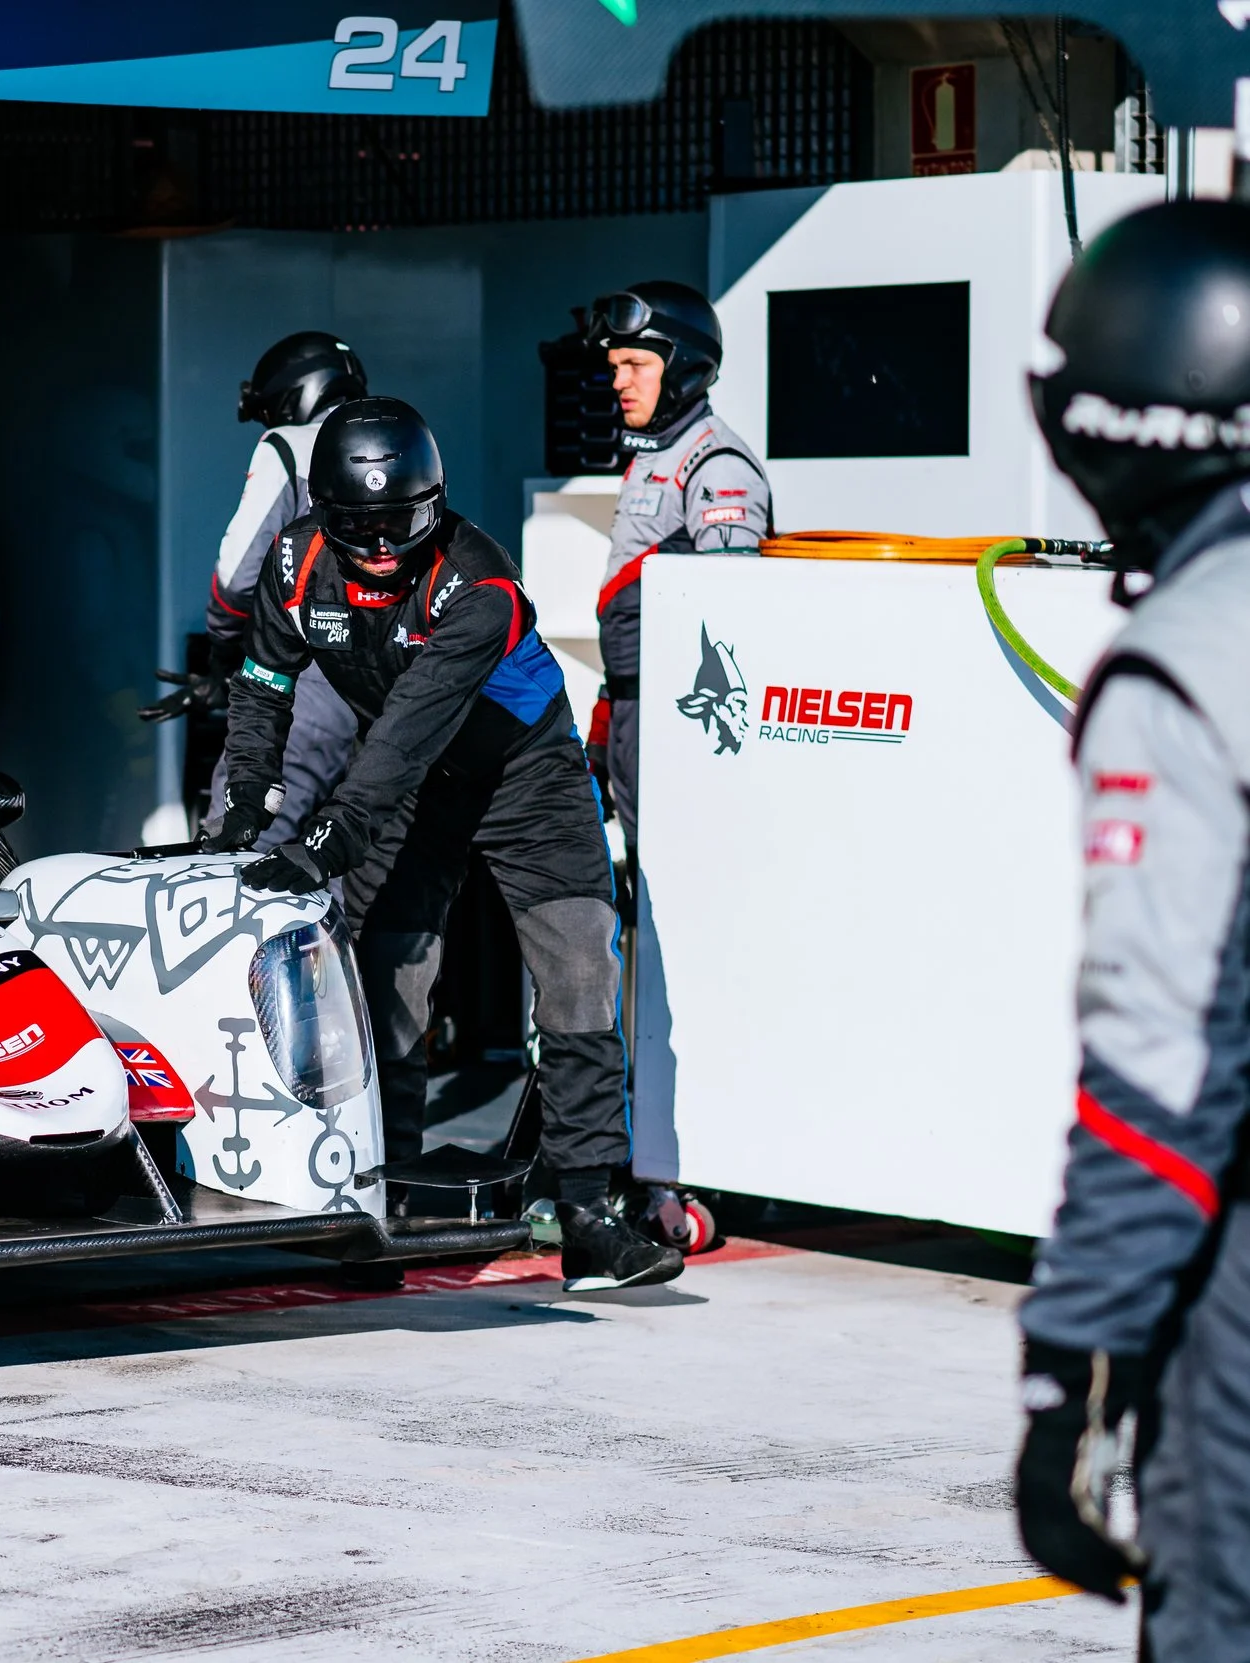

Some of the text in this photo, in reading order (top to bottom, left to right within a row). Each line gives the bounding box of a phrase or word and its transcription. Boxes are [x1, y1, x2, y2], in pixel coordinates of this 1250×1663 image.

[329, 16, 467, 92] 24
[624, 436, 658, 449] HRX
[281, 537, 295, 585] HRX
[430, 573, 463, 618] HRX
[309, 618, 343, 631] LE MANS
[316, 611, 349, 619] MICHELIN
[327, 628, 350, 643] CUP
[761, 686, 913, 731] NIELSEN
[759, 725, 829, 744] RACING
